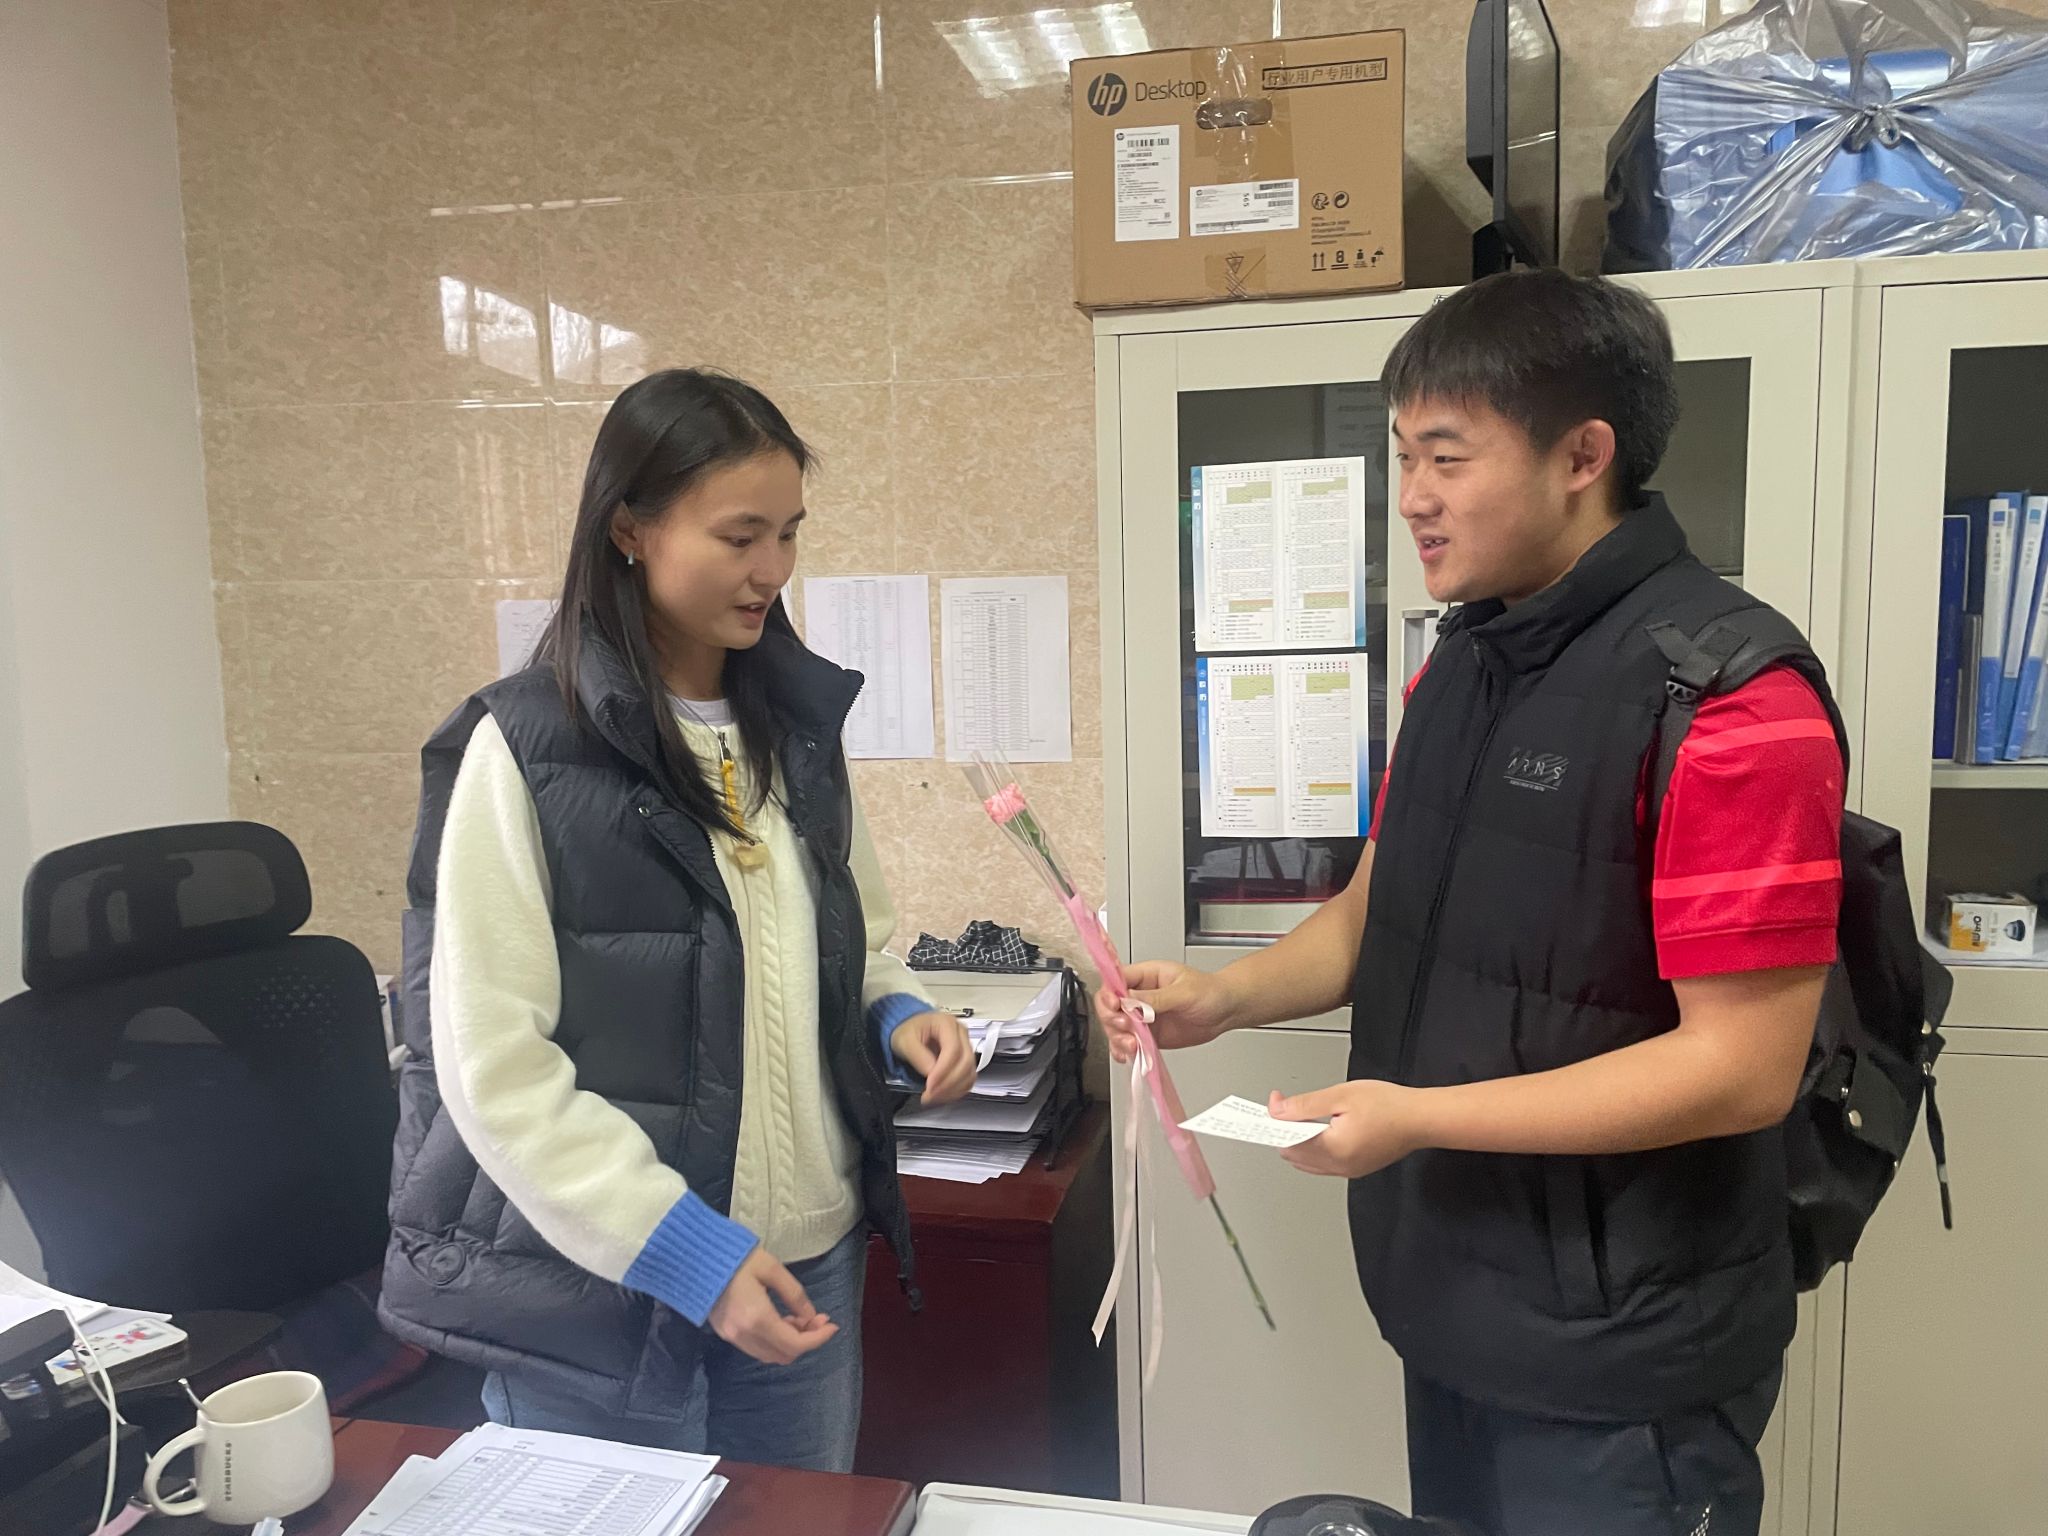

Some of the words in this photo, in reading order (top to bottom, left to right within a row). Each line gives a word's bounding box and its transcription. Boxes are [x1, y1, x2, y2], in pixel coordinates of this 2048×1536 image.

[1267, 62, 1383, 86] 行业用户专用机型
[1090, 74, 1125, 116] hp
[1135, 79, 1207, 101] Desktop
